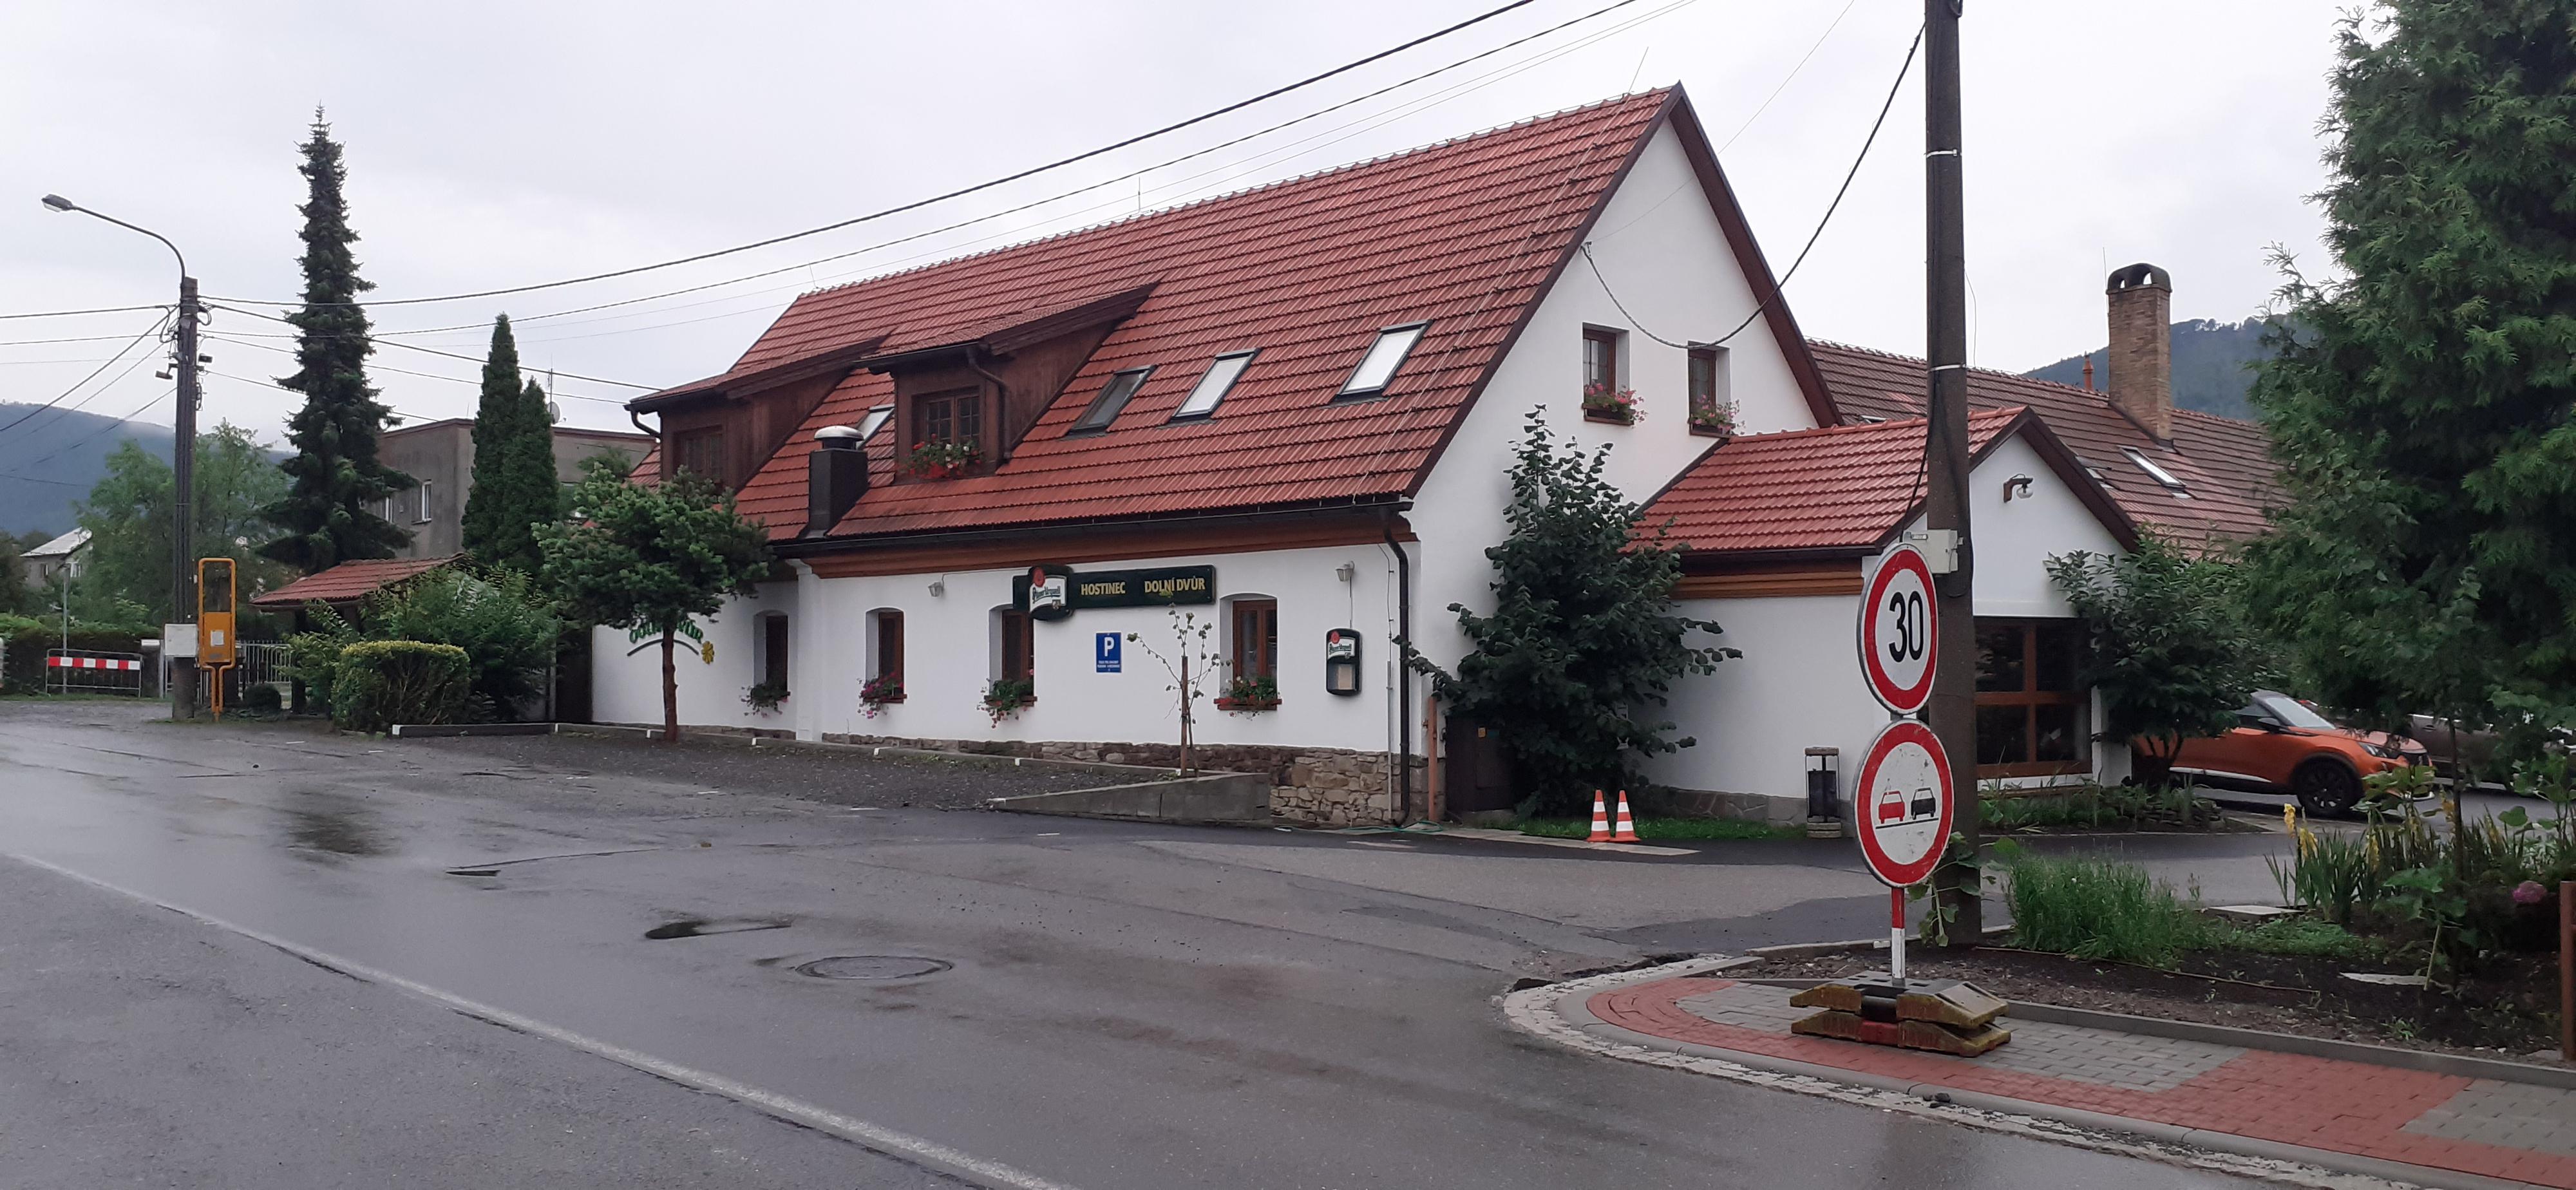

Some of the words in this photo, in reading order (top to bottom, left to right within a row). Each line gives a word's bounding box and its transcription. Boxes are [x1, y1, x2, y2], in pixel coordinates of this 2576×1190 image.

[1081, 581, 1126, 596] HOSTINEC
[1144, 577, 1175, 593] DOLNÍ
[1177, 576, 1206, 591] DVŮR
[1889, 590, 1924, 663] 30
[1104, 637, 1114, 657] P
